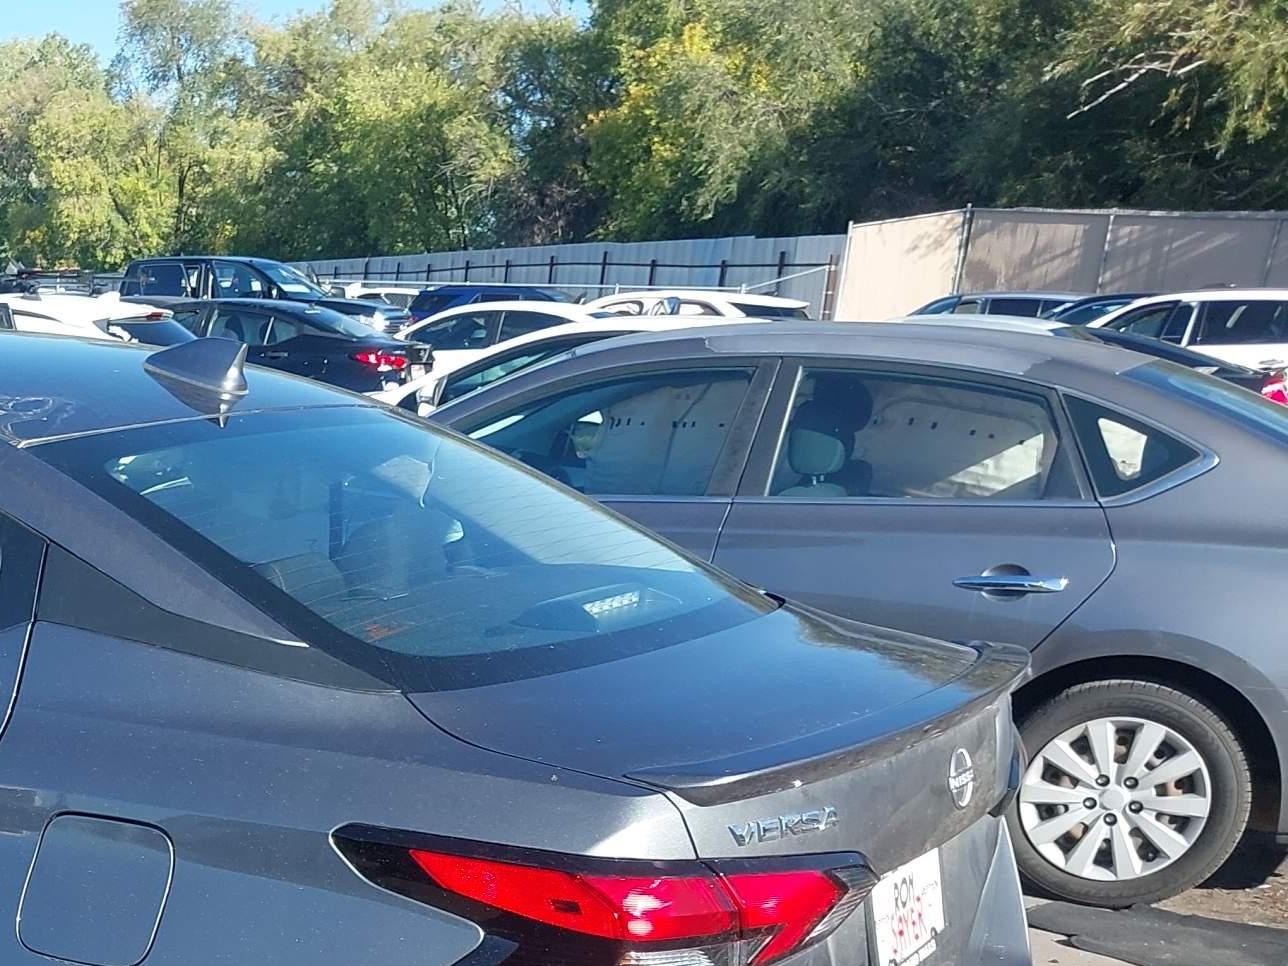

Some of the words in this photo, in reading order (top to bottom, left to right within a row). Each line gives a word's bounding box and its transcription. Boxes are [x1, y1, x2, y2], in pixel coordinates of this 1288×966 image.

[948, 769, 973, 790] NISS
[727, 806, 839, 847] VERSA
[893, 872, 916, 915] RON
